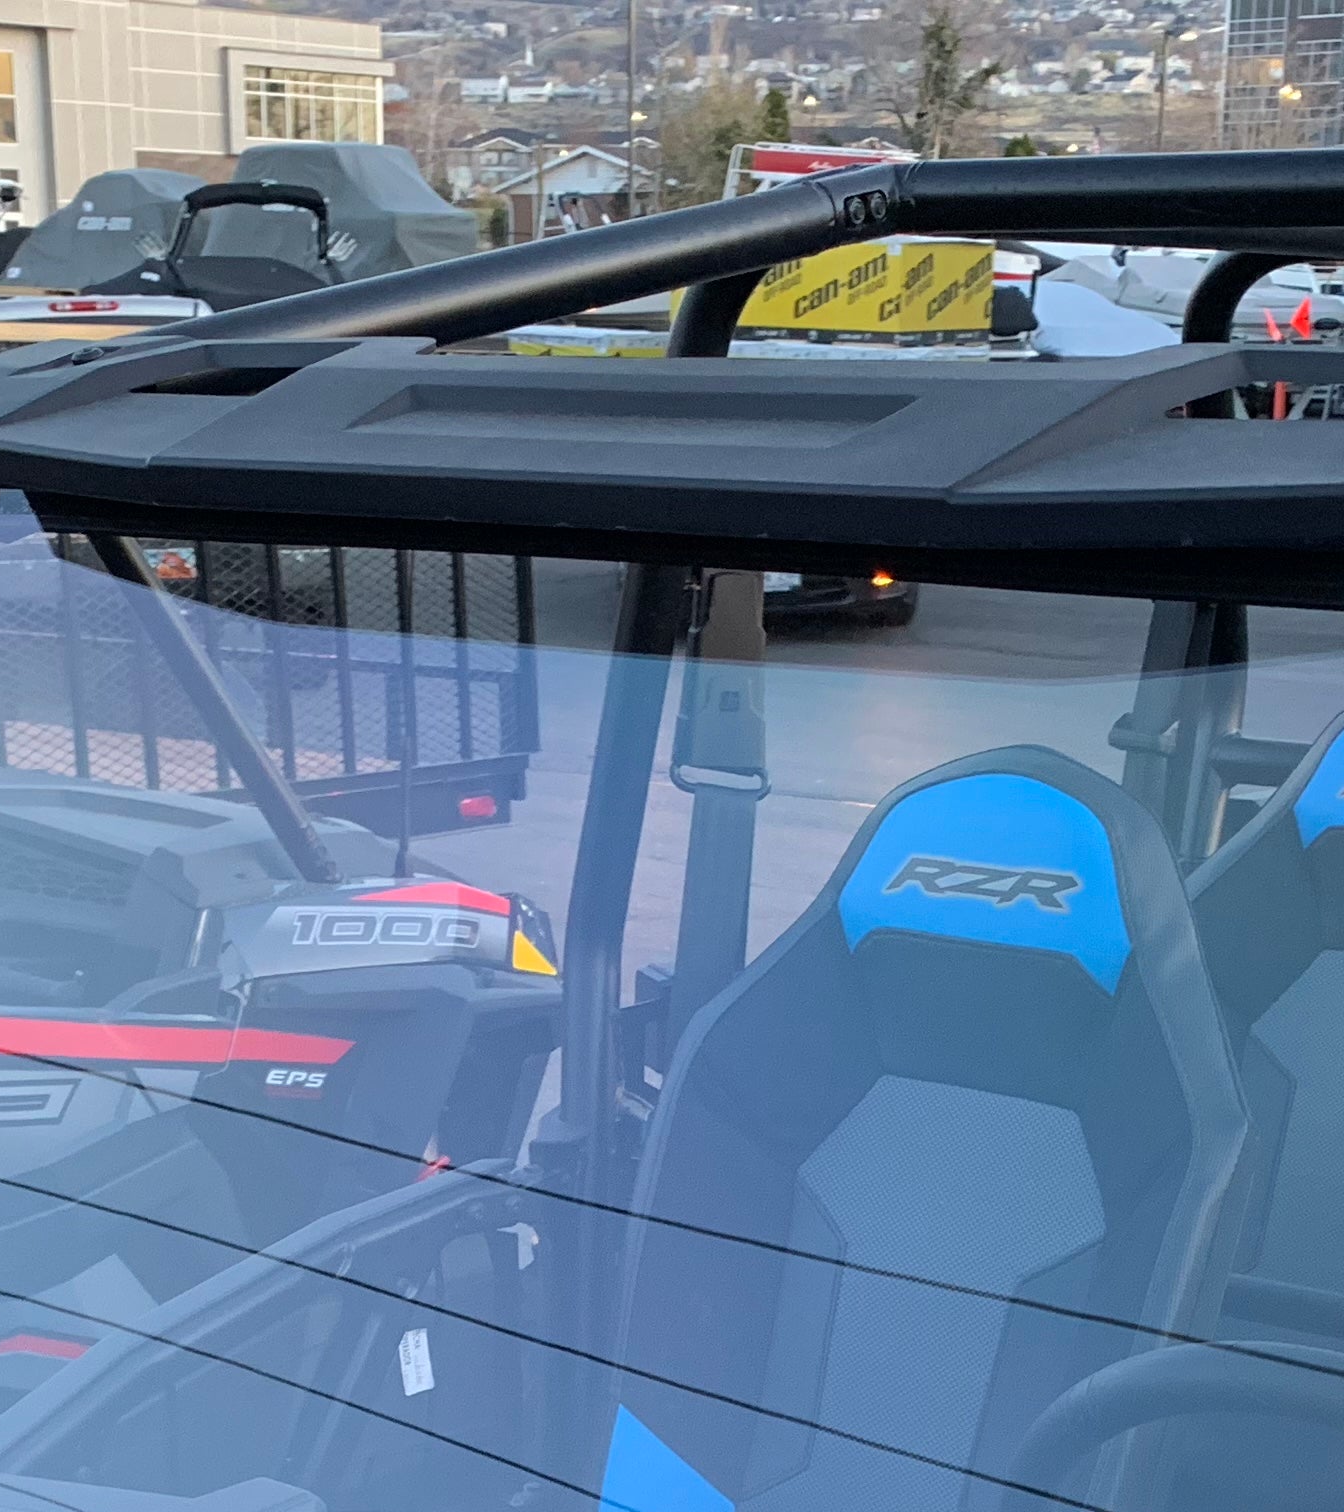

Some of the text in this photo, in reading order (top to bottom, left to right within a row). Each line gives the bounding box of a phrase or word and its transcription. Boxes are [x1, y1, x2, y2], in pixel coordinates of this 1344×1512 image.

[883, 855, 1081, 910] RZR
[292, 910, 480, 949] 1000
[265, 1069, 328, 1088] EPS
